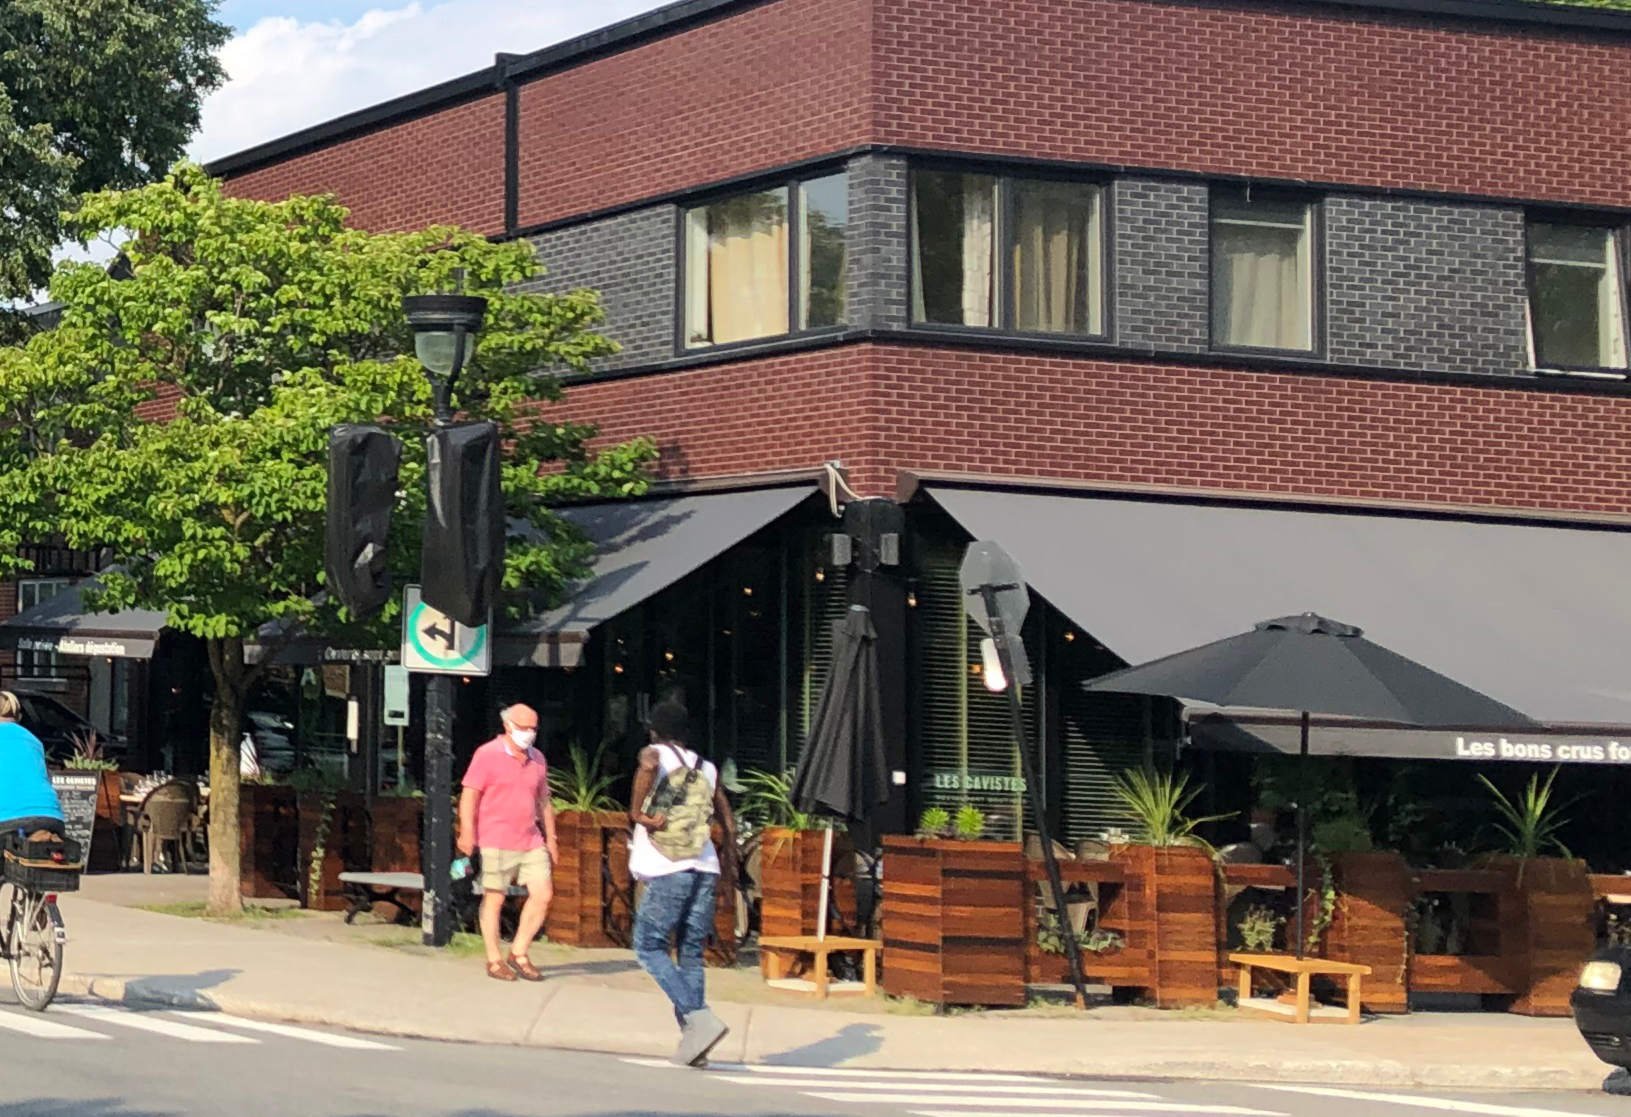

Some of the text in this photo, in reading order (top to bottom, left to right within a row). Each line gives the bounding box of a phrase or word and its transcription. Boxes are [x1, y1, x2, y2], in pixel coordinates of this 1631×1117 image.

[1455, 736, 1631, 761] Les bons crus fo
[935, 774, 1027, 792] LES CAVISTES
